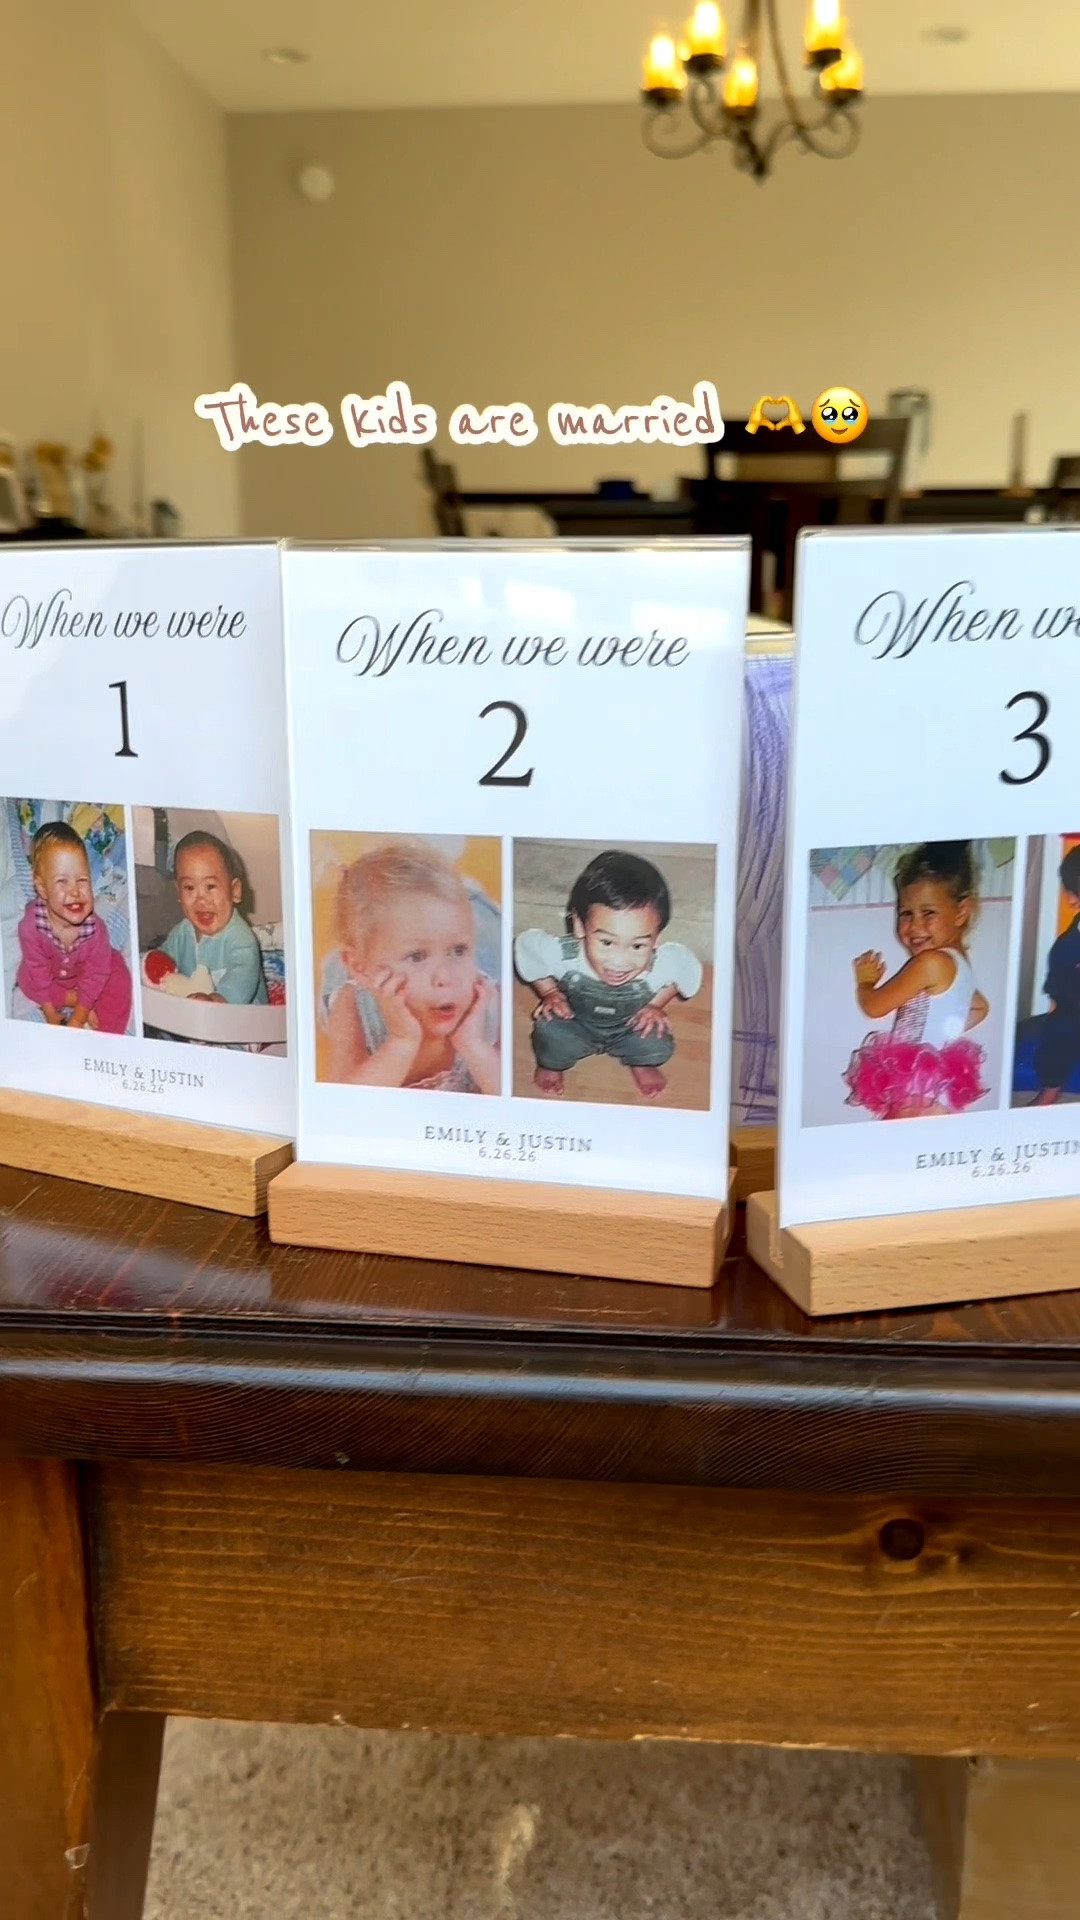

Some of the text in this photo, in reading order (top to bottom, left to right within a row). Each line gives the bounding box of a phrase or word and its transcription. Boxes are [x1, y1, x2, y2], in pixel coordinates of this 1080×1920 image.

[1, 588, 247, 650] When we were
[853, 579, 1080, 660] When w
[336, 608, 691, 678] When we were
[108, 679, 139, 759] 1
[997, 690, 1053, 786] 3
[476, 699, 536, 789] 2
[84, 1058, 205, 1088] EMILY & JUSTIN
[122, 1078, 165, 1094] 6.26.26
[424, 1125, 593, 1153] EMILY & JUSTIN
[478, 1146, 537, 1163] 6.26.26
[915, 1149, 982, 1170] EMILY
[991, 1147, 1005, 1162] &
[970, 1161, 1031, 1179] 6.26.26
